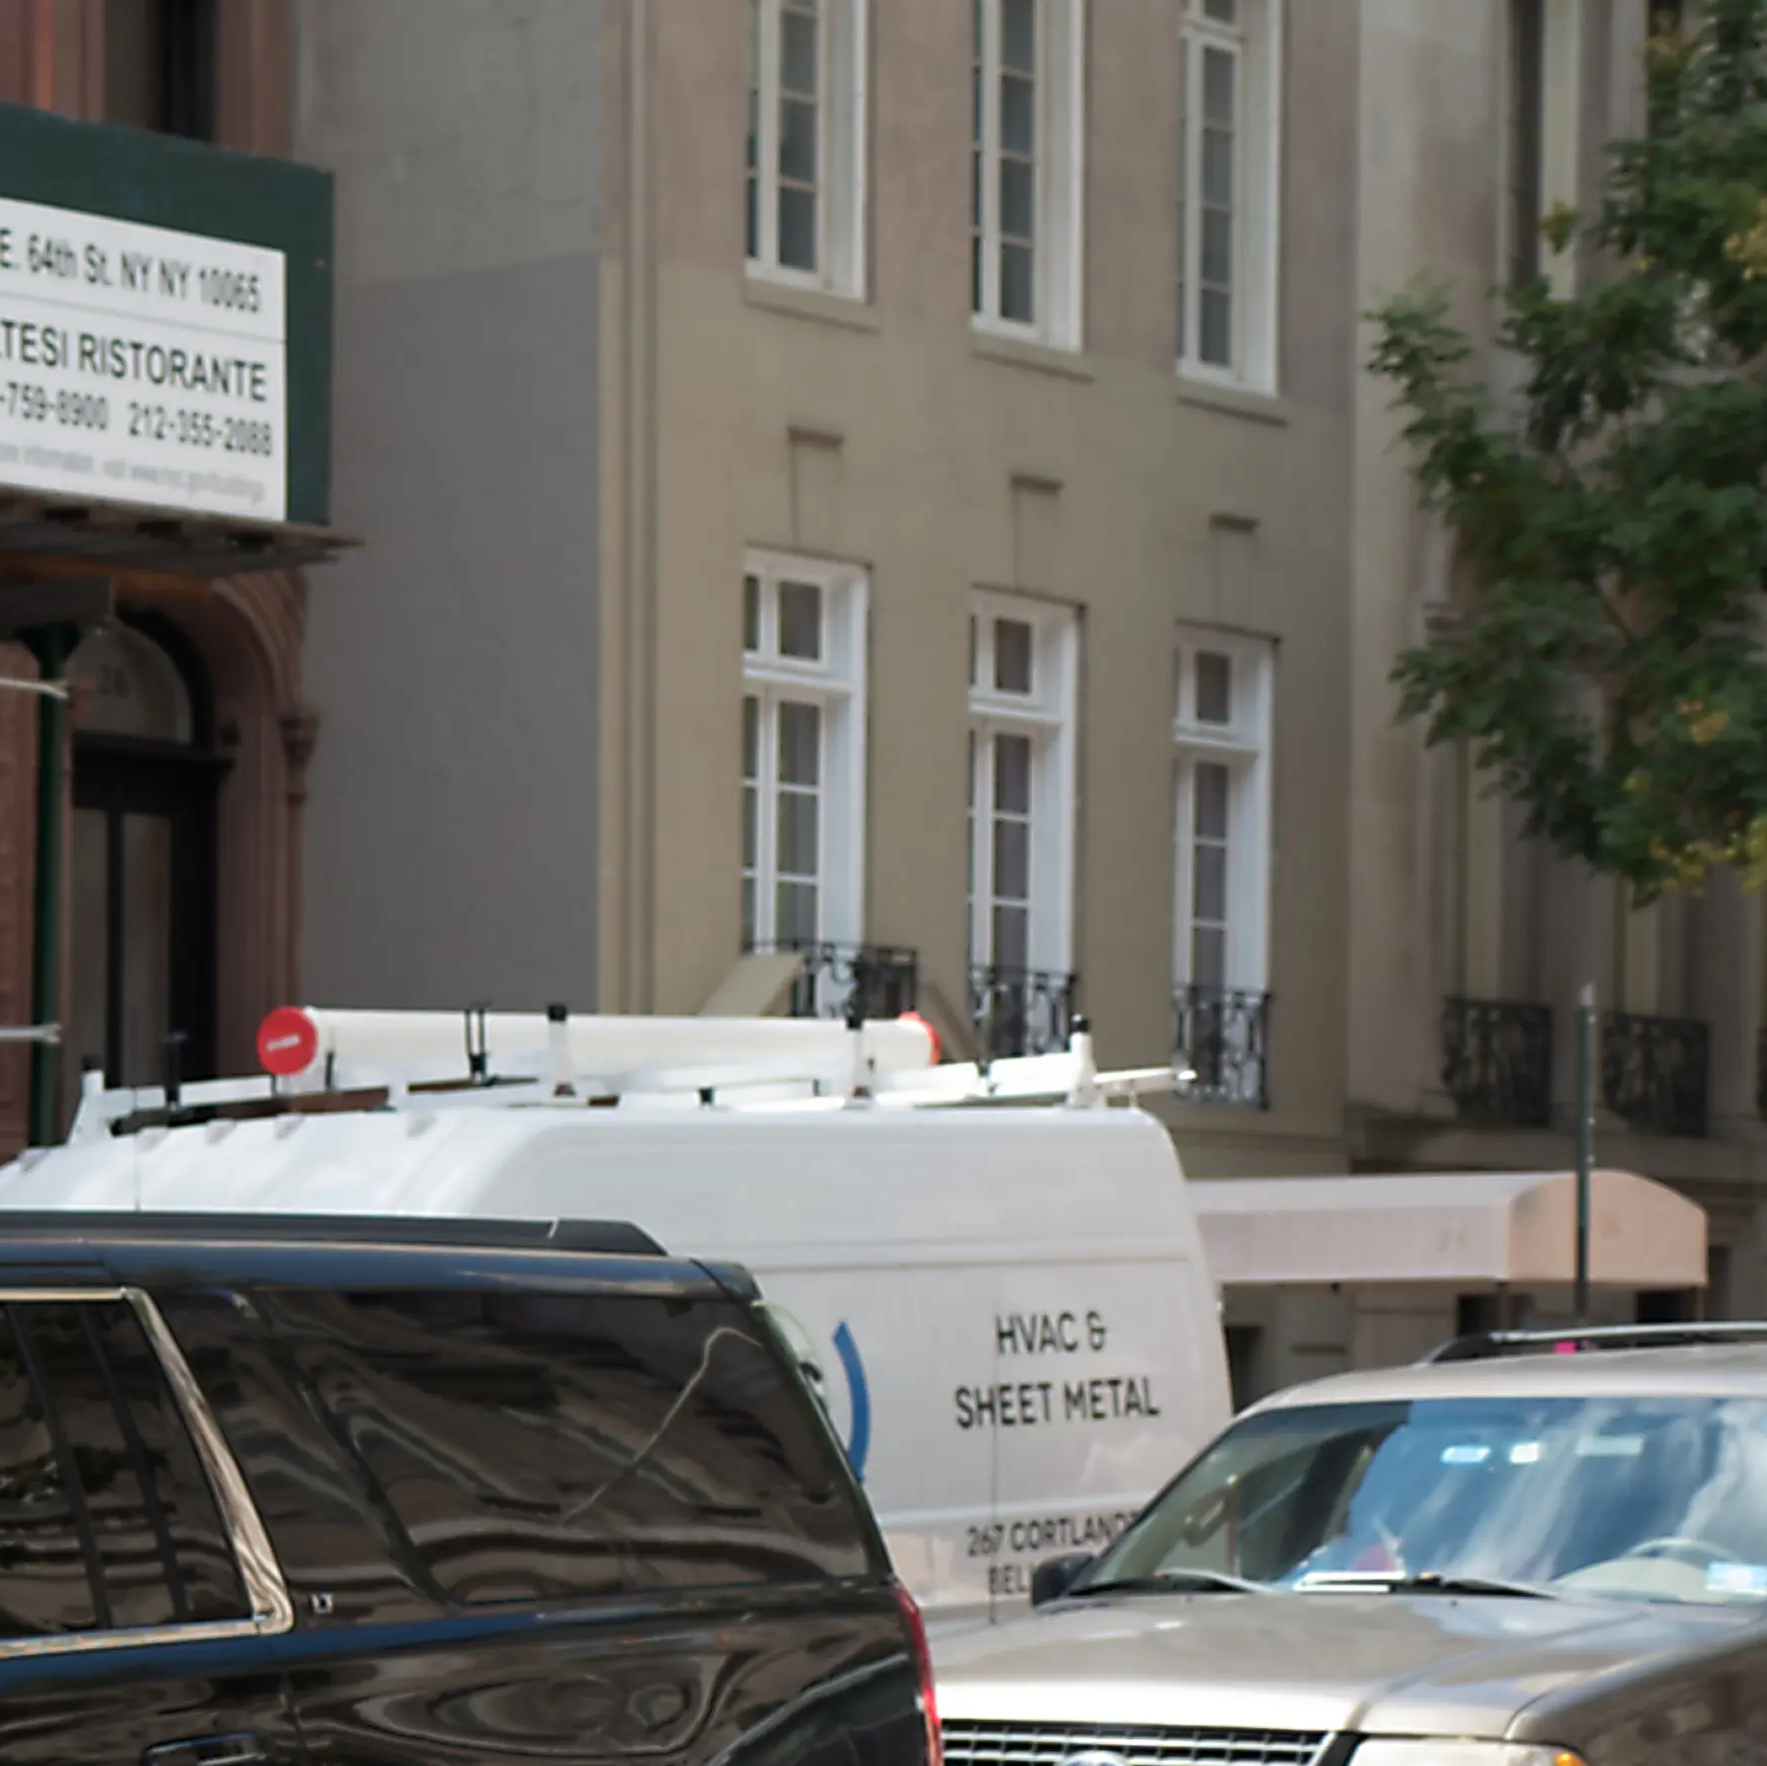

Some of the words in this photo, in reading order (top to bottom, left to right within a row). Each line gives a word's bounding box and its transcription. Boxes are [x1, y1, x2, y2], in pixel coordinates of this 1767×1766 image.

[27, 232, 77, 279] 64th
[120, 249, 152, 291] NY
[157, 258, 190, 299] NY
[198, 265, 261, 314] 10065
[77, 331, 268, 403] RISTORANTE
[995, 1312, 1079, 1355] HVAC
[1086, 1310, 1107, 1352] &
[954, 1382, 1053, 1430] SHEET
[1064, 1377, 1161, 1420] METAL
[967, 1523, 1004, 1558] 267
[1010, 1511, 1139, 1552] CORTLAND
